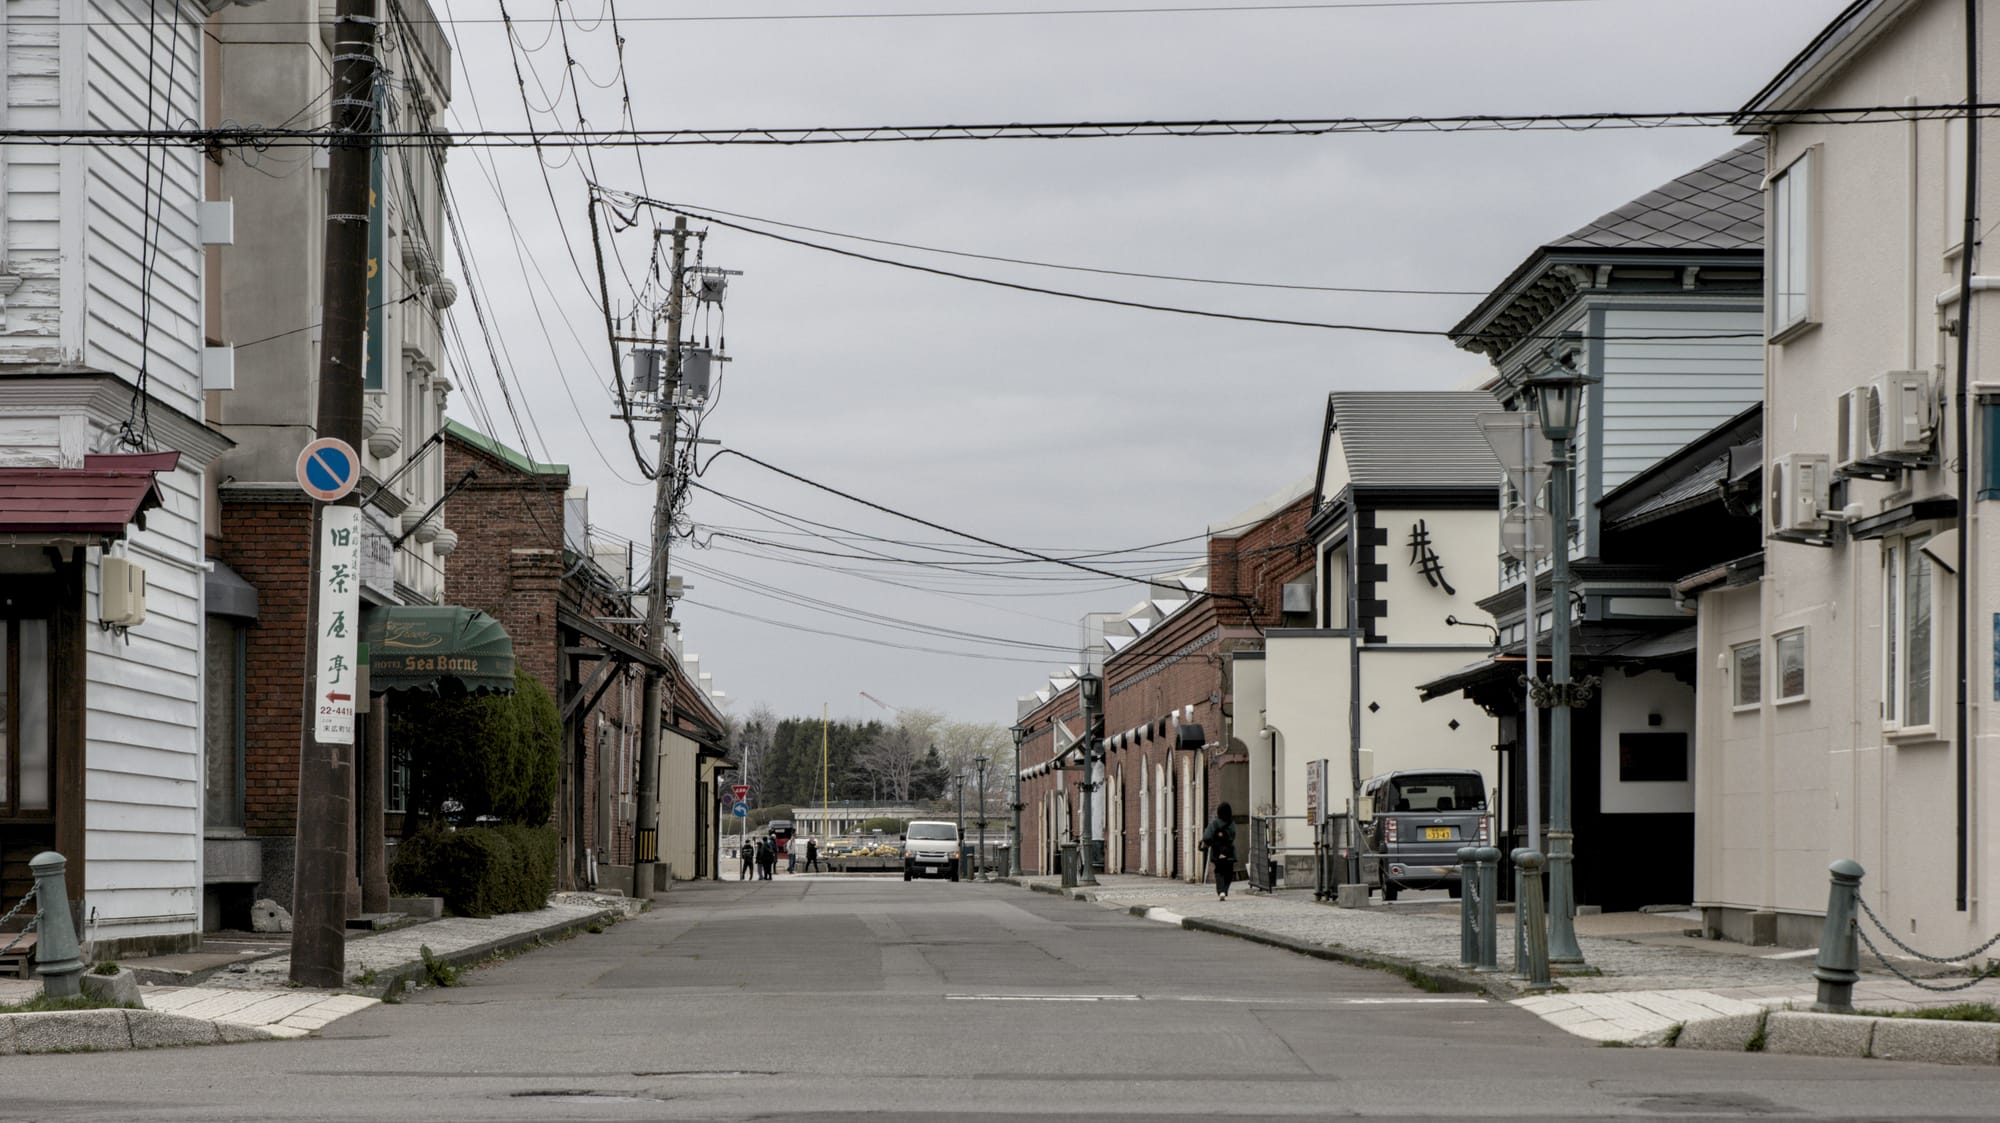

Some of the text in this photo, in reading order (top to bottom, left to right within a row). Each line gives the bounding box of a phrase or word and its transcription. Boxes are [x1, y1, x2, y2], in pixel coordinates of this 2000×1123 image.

[326, 527, 351, 685] 旧茶屋亭
[404, 656, 434, 671] Sea
[436, 655, 479, 672] Borne
